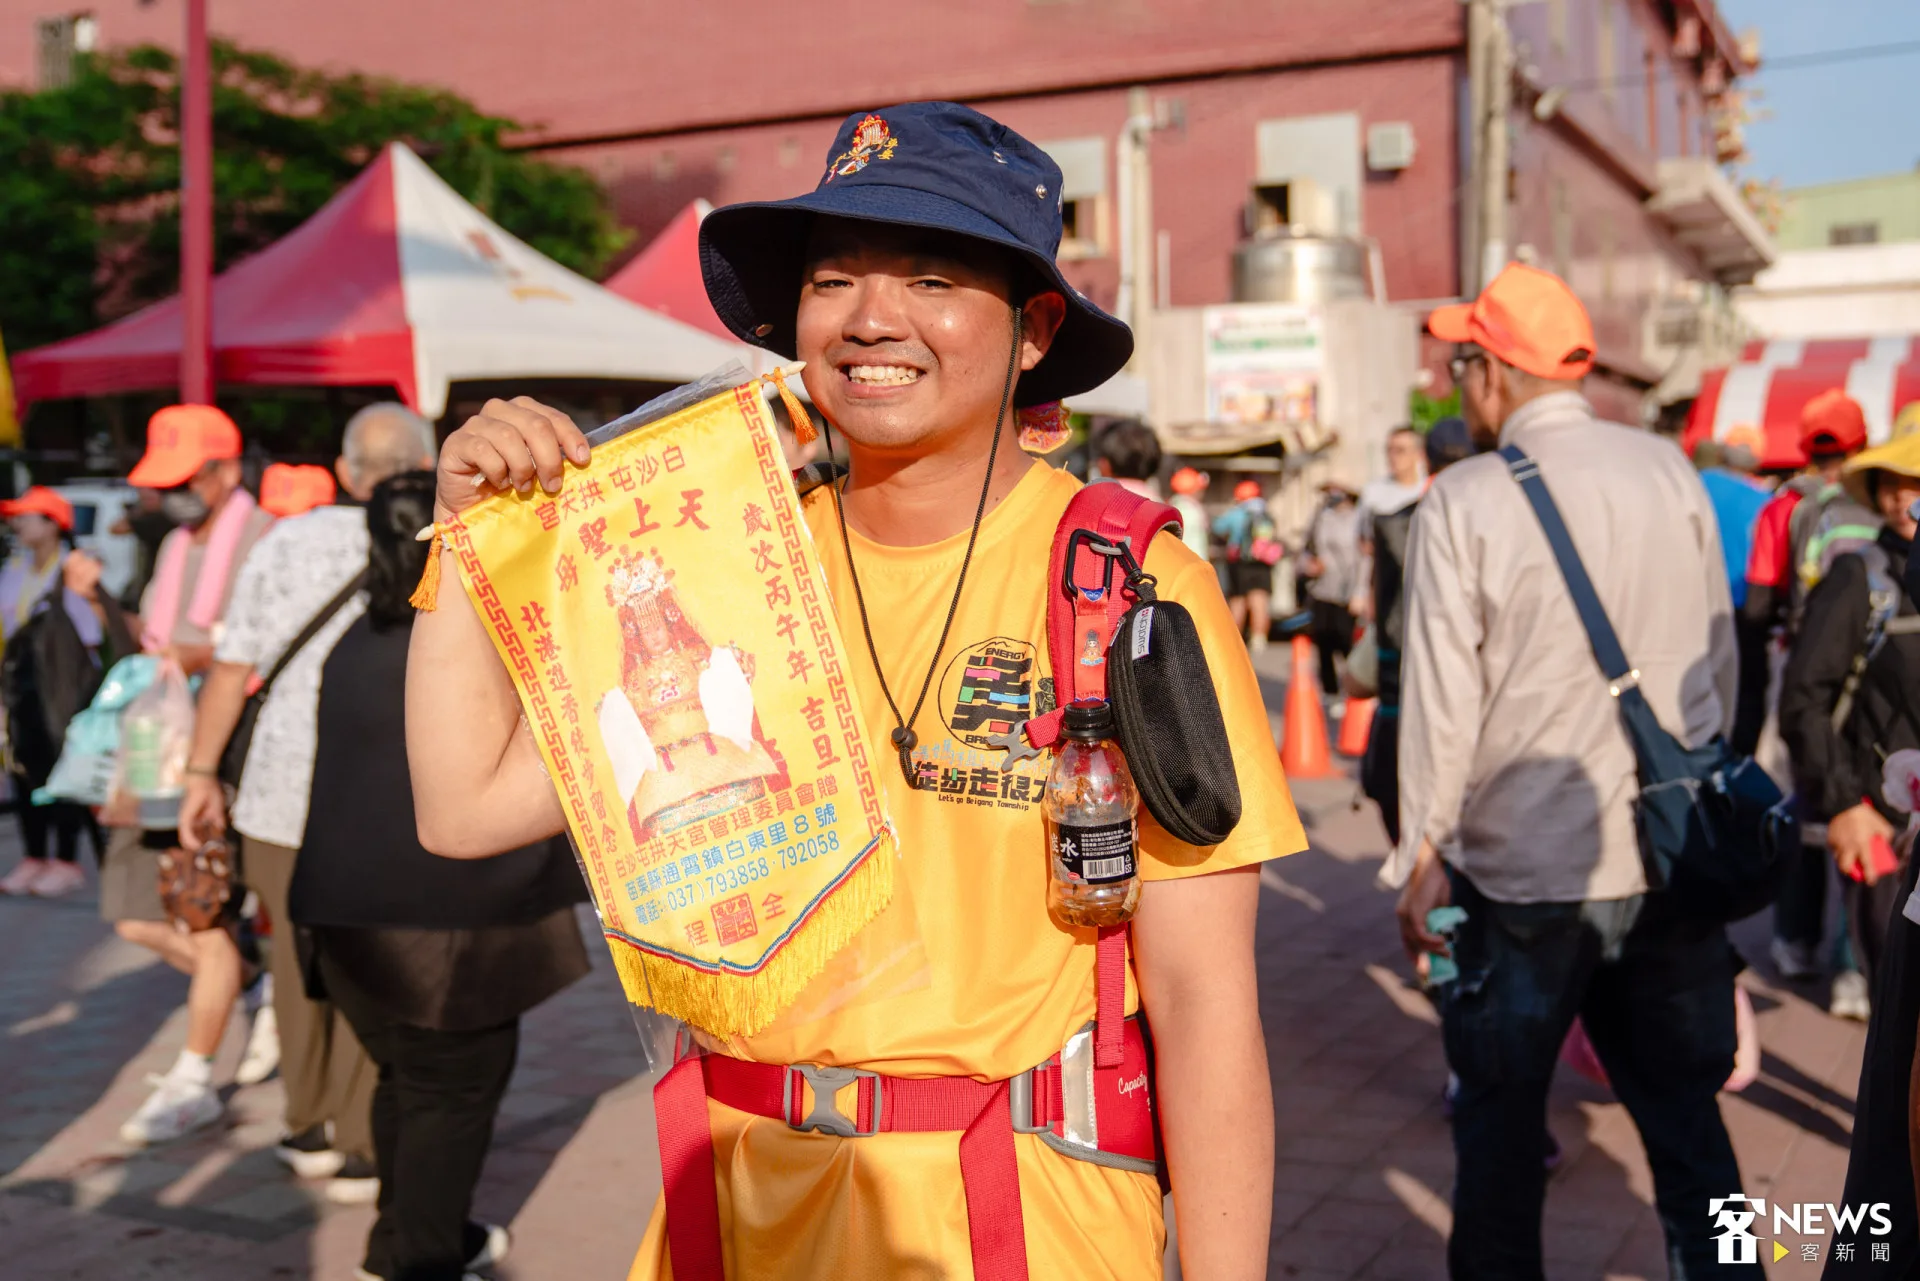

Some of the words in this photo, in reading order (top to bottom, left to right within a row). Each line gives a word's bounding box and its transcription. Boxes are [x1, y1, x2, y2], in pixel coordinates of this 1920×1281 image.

[985, 647, 1026, 660] ENERGY
[997, 800, 1029, 811] Township
[615, 774, 838, 878] 白沙屯拱天宮管理委員會贈
[1118, 1070, 1148, 1098] Capacity
